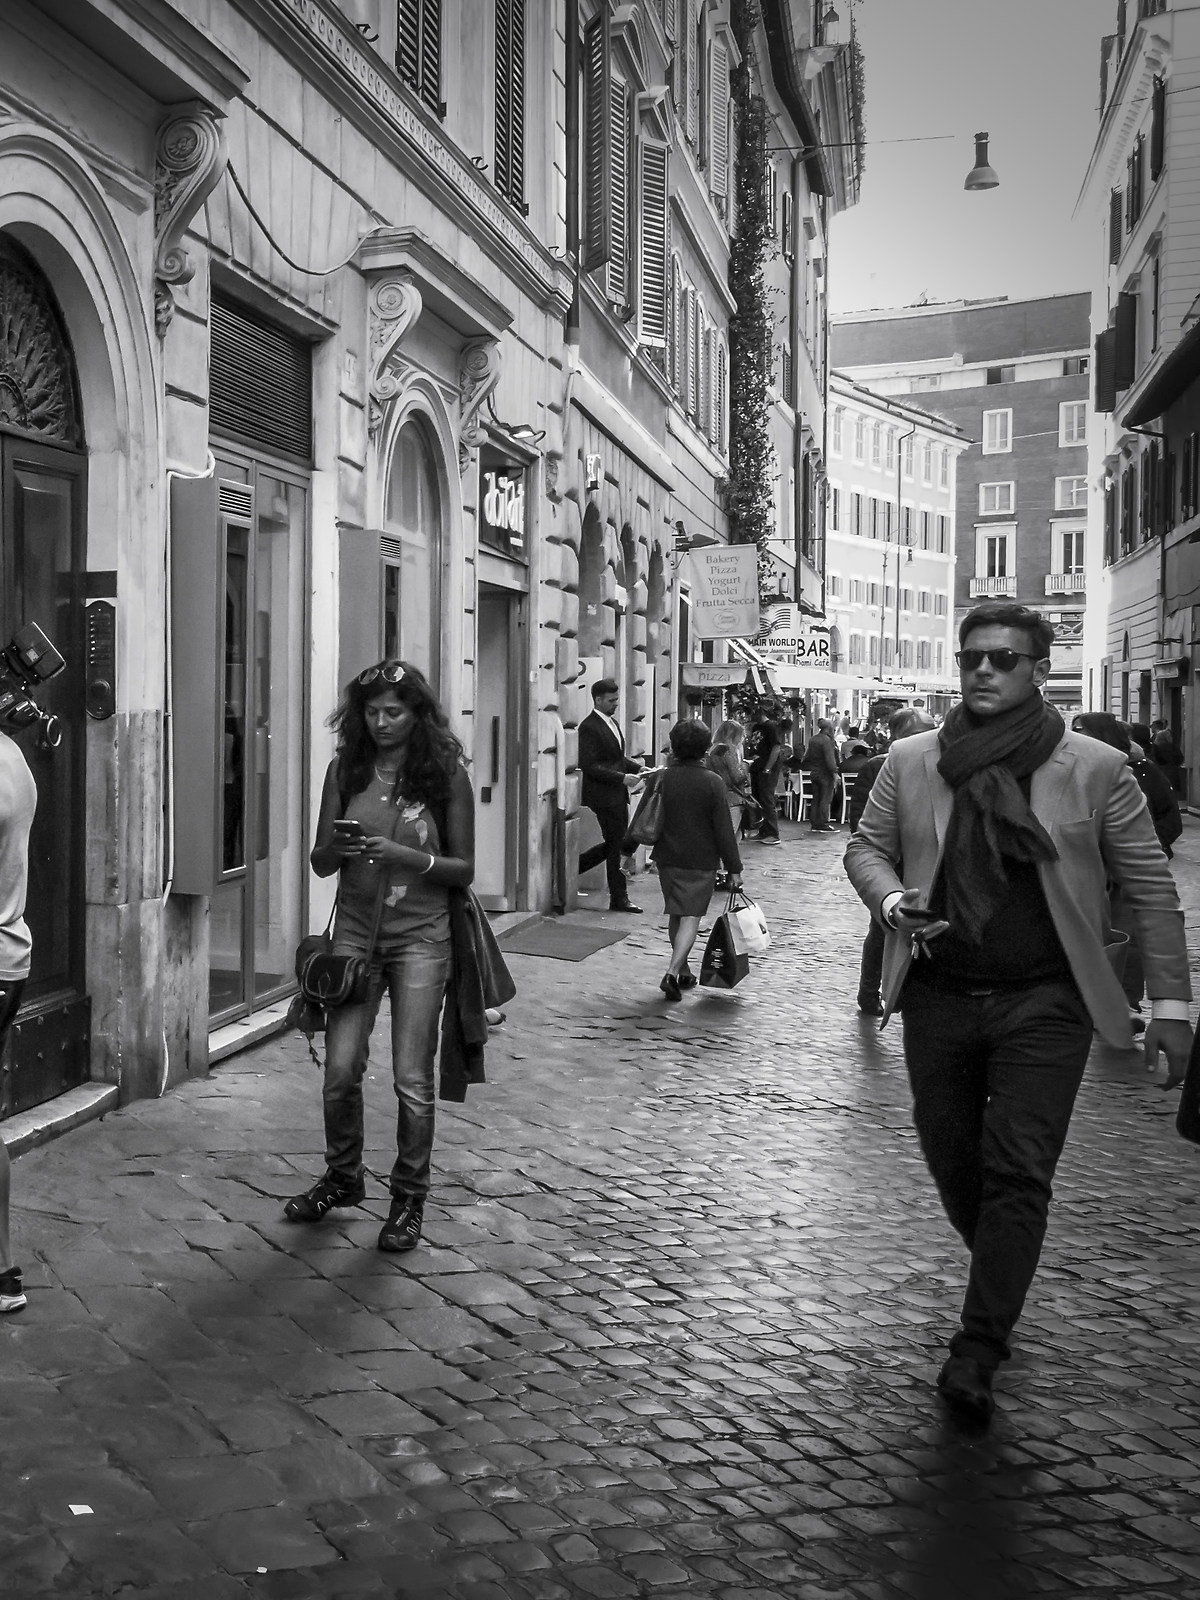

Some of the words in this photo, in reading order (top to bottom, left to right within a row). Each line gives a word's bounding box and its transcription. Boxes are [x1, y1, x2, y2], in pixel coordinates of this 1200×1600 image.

[706, 554, 740, 564] Bakery
[710, 566, 737, 574] Pizza
[708, 576, 741, 587] Yogurt
[712, 586, 738, 596] Dolci
[696, 599, 726, 607] Frutta
[727, 598, 755, 606] Secca
[769, 638, 796, 647] WORLD
[796, 638, 830, 657] BAR
[699, 672, 731, 683] pizza
